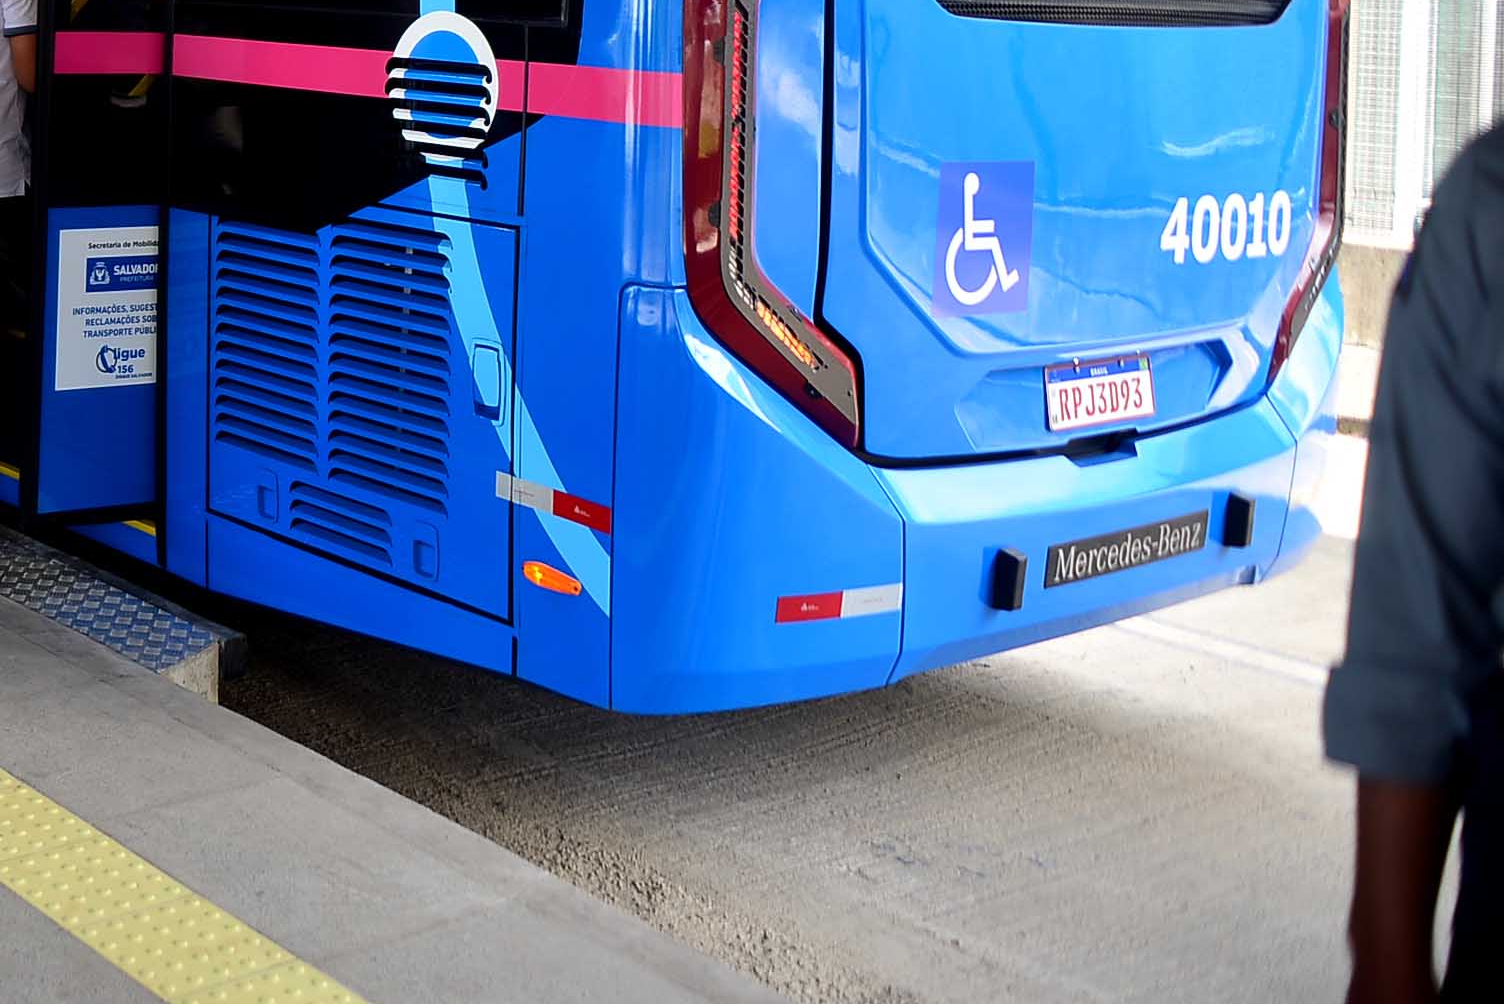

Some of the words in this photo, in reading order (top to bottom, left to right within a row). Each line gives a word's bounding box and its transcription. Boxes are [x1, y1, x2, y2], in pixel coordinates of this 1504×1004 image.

[1160, 188, 1292, 265] 40010
[83, 327, 133, 338] TRANSPORTE
[117, 364, 134, 374] 156
[1058, 377, 1143, 422] RPJ3D93
[1053, 520, 1202, 583] Mercedes-Benz
